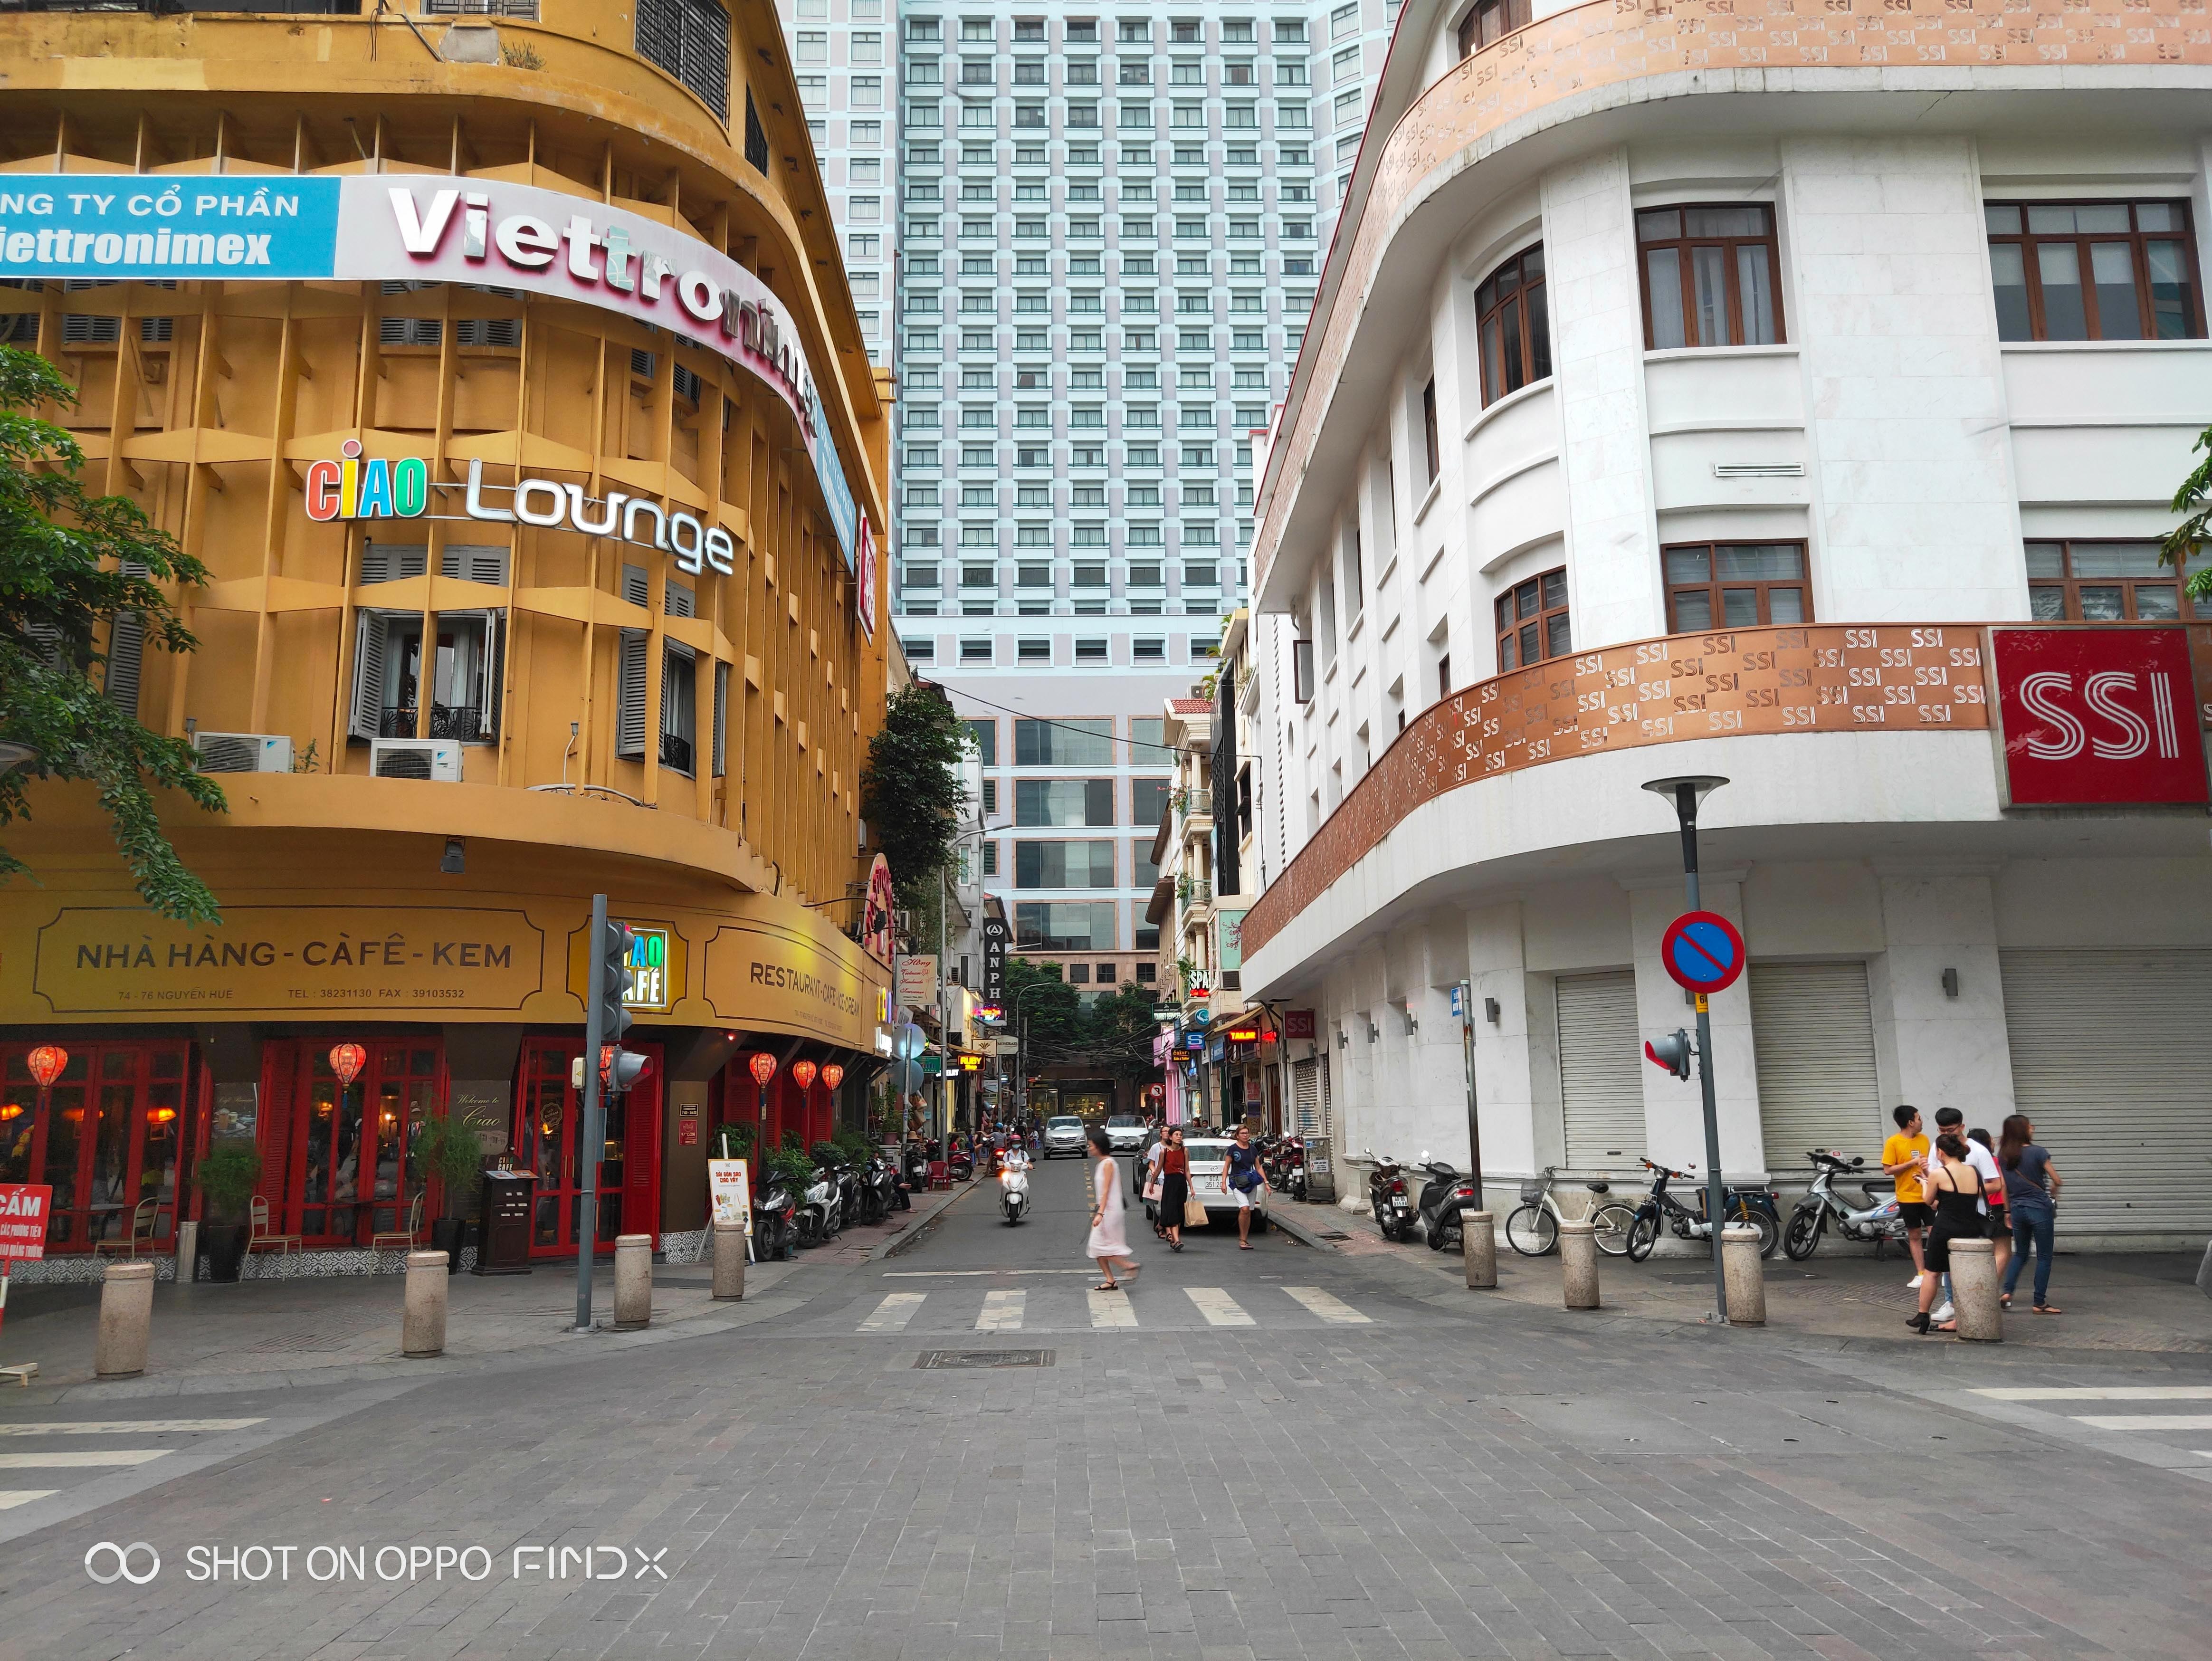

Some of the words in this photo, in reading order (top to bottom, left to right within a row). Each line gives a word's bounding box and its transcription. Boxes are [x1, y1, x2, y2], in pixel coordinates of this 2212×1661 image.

[1644, 6, 1673, 24] SSI
[1706, 1, 1734, 17] SSI
[1767, 0, 1795, 15] SSI
[1824, 0, 1852, 15] SSI
[1883, 0, 1912, 15] SSI
[1736, 16, 1764, 31] SSI
[1798, 16, 1825, 30] SSI
[1856, 16, 1884, 30] SSI
[1914, 15, 1943, 29] SSI
[1647, 36, 1676, 54] SSI
[1707, 31, 1737, 47] SSI
[1769, 30, 1798, 46] SSI
[1828, 30, 1855, 46] SSI
[1886, 30, 1916, 45] SSI
[1948, 29, 1976, 45] SSI
[2126, 28, 2155, 44] SSI
[1500, 35, 1524, 58] SSI
[1739, 47, 1767, 62] SSI
[1800, 46, 1828, 61] SSI
[1860, 46, 1888, 61] SSI
[1917, 45, 1945, 61] SSI
[2038, 44, 2067, 60] SSI
[1477, 63, 1497, 86] SSI
[68, 195, 116, 215] TY
[127, 185, 182, 216] CỔ
[195, 186, 299, 217] PHẦN
[0, 227, 271, 265] iettronimex
[465, 457, 734, 576] Lounge
[1702, 635, 1736, 655] SSI
[1845, 630, 1877, 648] SSI
[1910, 629, 1943, 647] SSI
[1636, 643, 1668, 664] SSI
[1743, 651, 1776, 670] SSI
[1880, 649, 1912, 667] SSI
[1949, 648, 1981, 667] SSI
[1575, 654, 1602, 677] SSI
[1671, 658, 1704, 678] SSI
[1605, 667, 1635, 689] SSI
[1706, 673, 1739, 693] SSI
[1849, 668, 1881, 687] SSI
[1914, 667, 1947, 686] SSI
[1482, 683, 1500, 704] SSI
[1639, 680, 1670, 701] SSI
[1746, 688, 1779, 707] SSI
[1884, 686, 1916, 705] SSI
[1954, 685, 1986, 705] SSI
[1578, 691, 1605, 713] SSI
[1674, 694, 1707, 715] SSI
[1464, 706, 1481, 728] SSI
[1608, 703, 1638, 725] SSI
[1708, 710, 1742, 731] SSI
[1783, 706, 1816, 725] SSI
[1852, 706, 1885, 723] SSI
[1918, 705, 1951, 723] SSI
[2020, 671, 2179, 760] SSI
[1483, 717, 1502, 737] SSI
[1581, 727, 1607, 749] SSI
[1466, 739, 1484, 761] SSI
[1528, 738, 1550, 760] SSI
[1486, 750, 1505, 772] SSI
[76, 934, 157, 969] NHÀ
[168, 934, 276, 968] HÀNG
[303, 932, 406, 966] CÀFÊ
[432, 942, 511, 969] KEM
[1191, 971, 1209, 989] SPA
[118, 992, 130, 1001] 74
[142, 992, 153, 1000] 76
[288, 990, 309, 998] TEL
[320, 989, 372, 998] 38231130
[379, 989, 401, 998] FAX
[412, 989, 465, 998] 39103532
[1287, 1018, 1312, 1032] SSI
[457, 1094, 490, 1105] Welcome
[461, 1105, 502, 1127] Ciao
